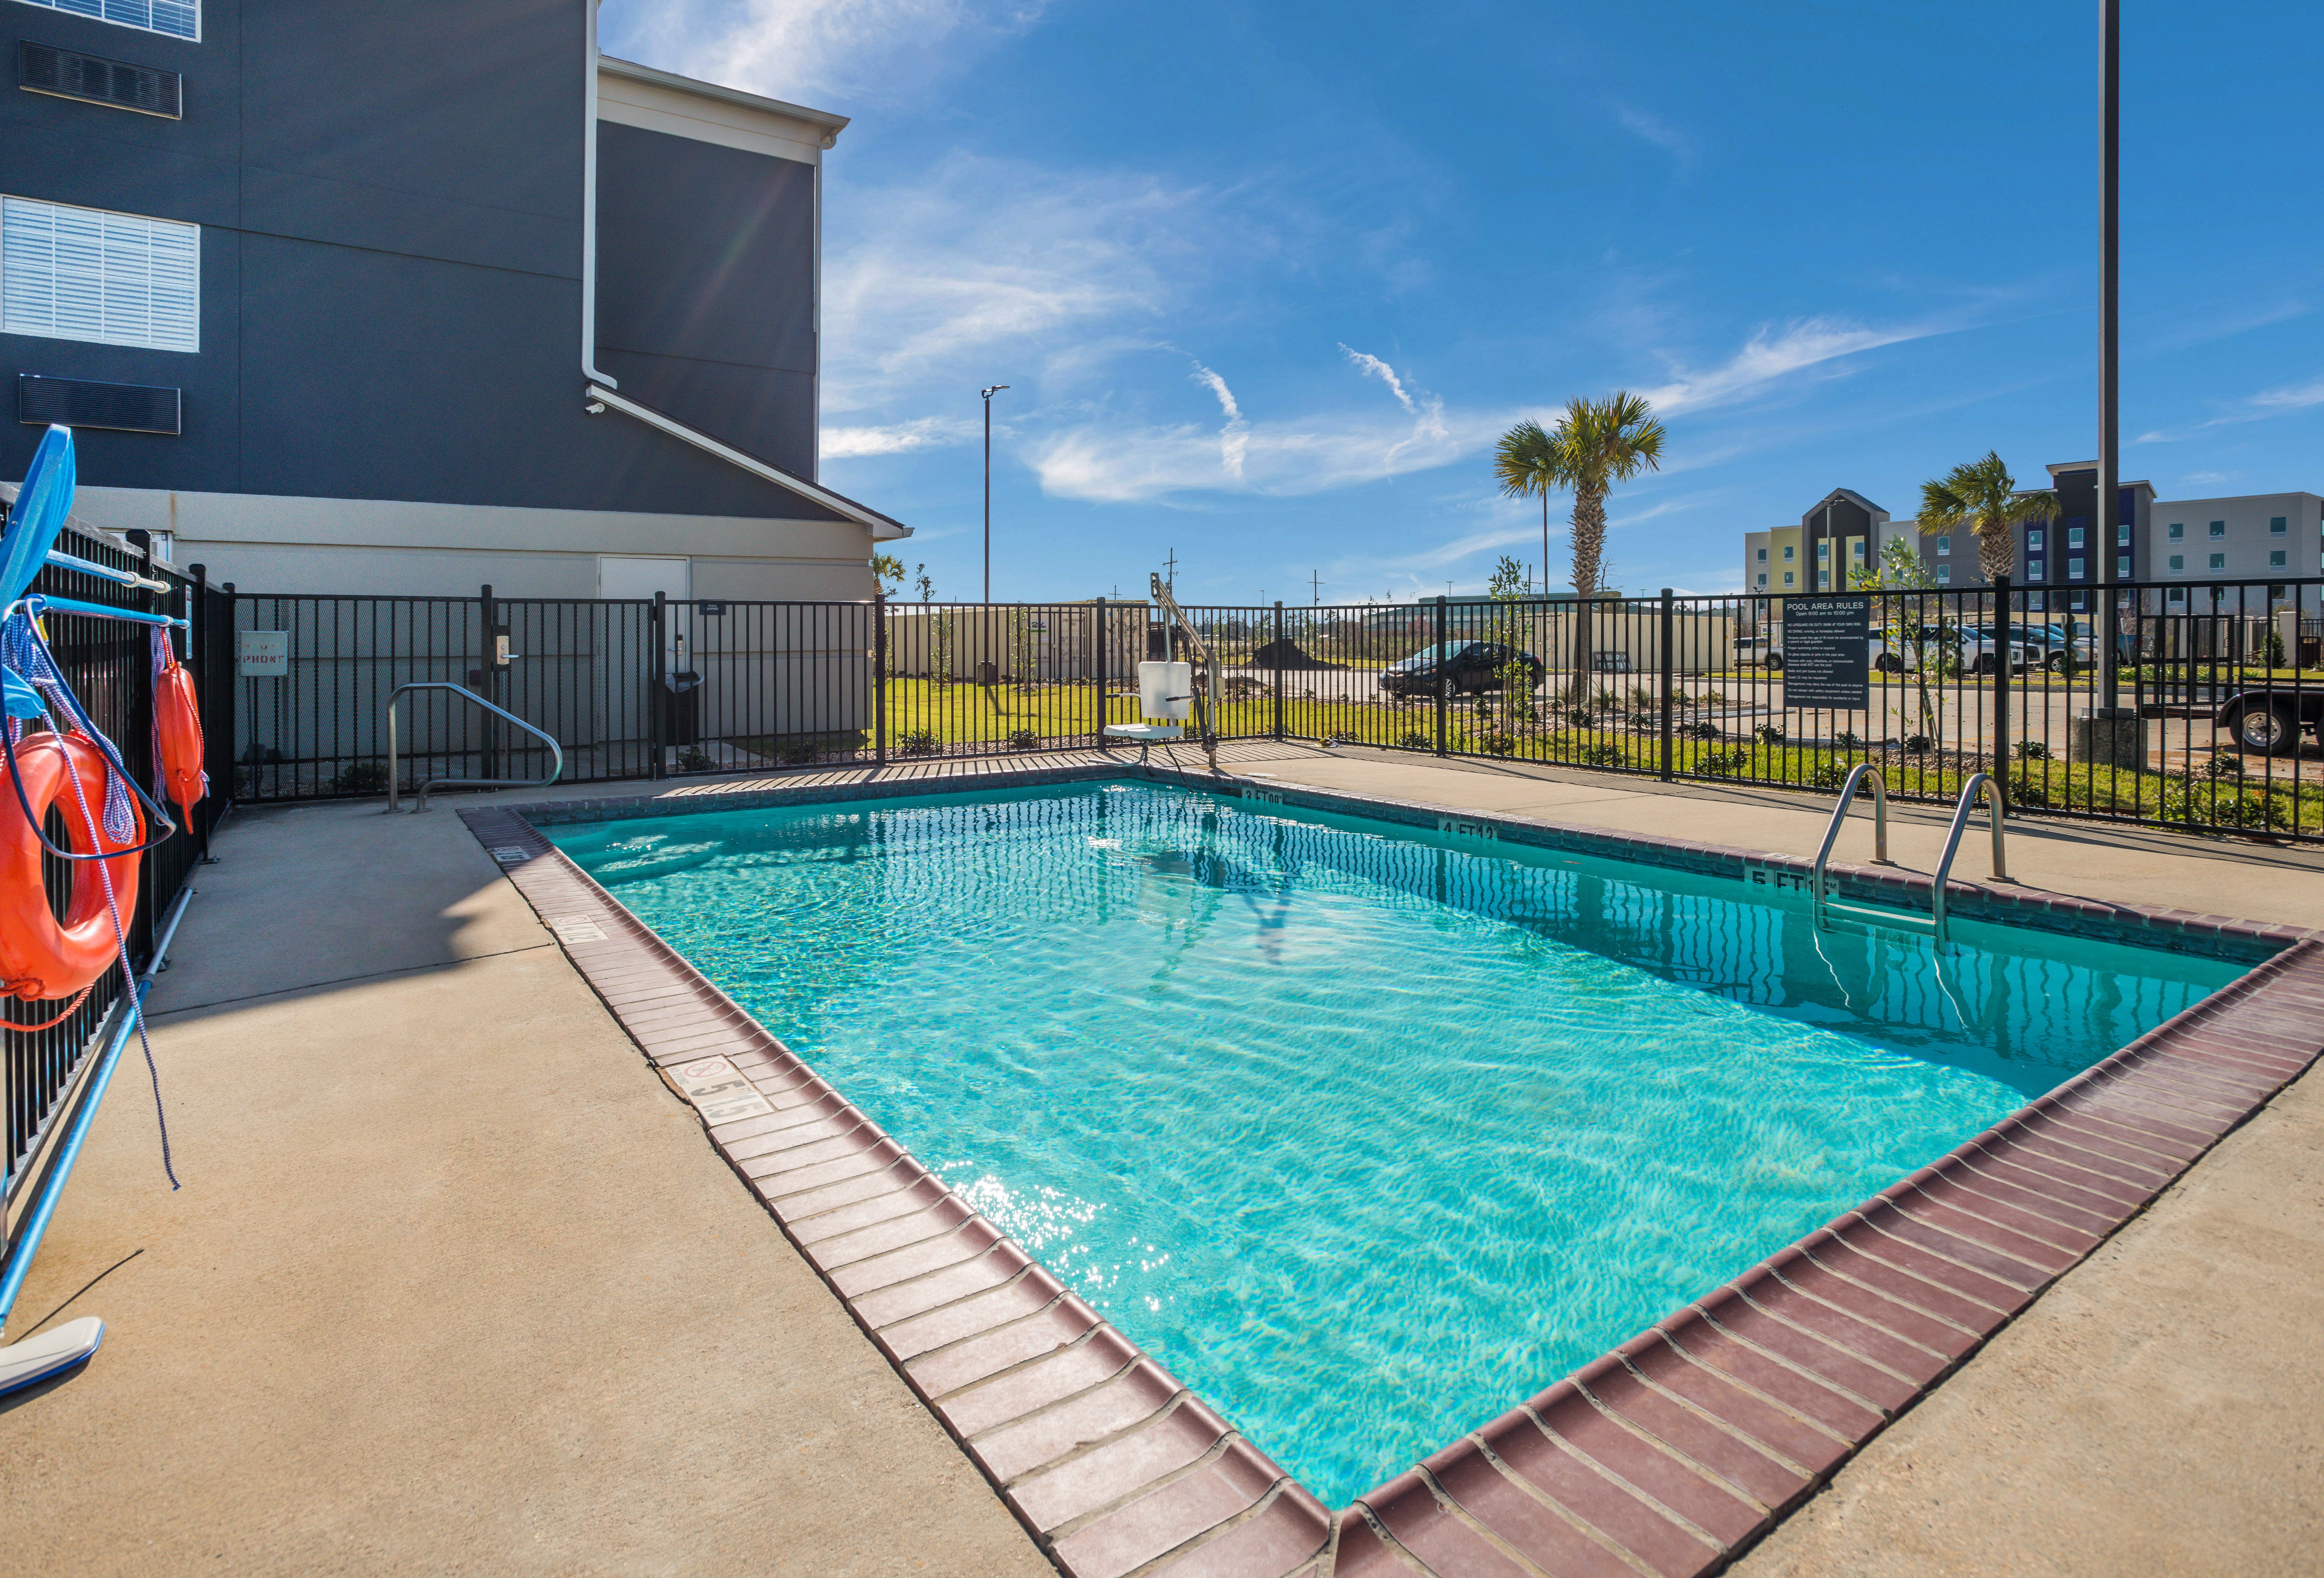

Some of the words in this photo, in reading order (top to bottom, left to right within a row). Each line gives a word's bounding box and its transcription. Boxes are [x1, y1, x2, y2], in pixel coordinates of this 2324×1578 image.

[1256, 790, 1268, 802] FT
[1459, 824, 1475, 836] FT
[1777, 872, 1804, 891] FT
[672, 1071, 690, 1085] DIVING
